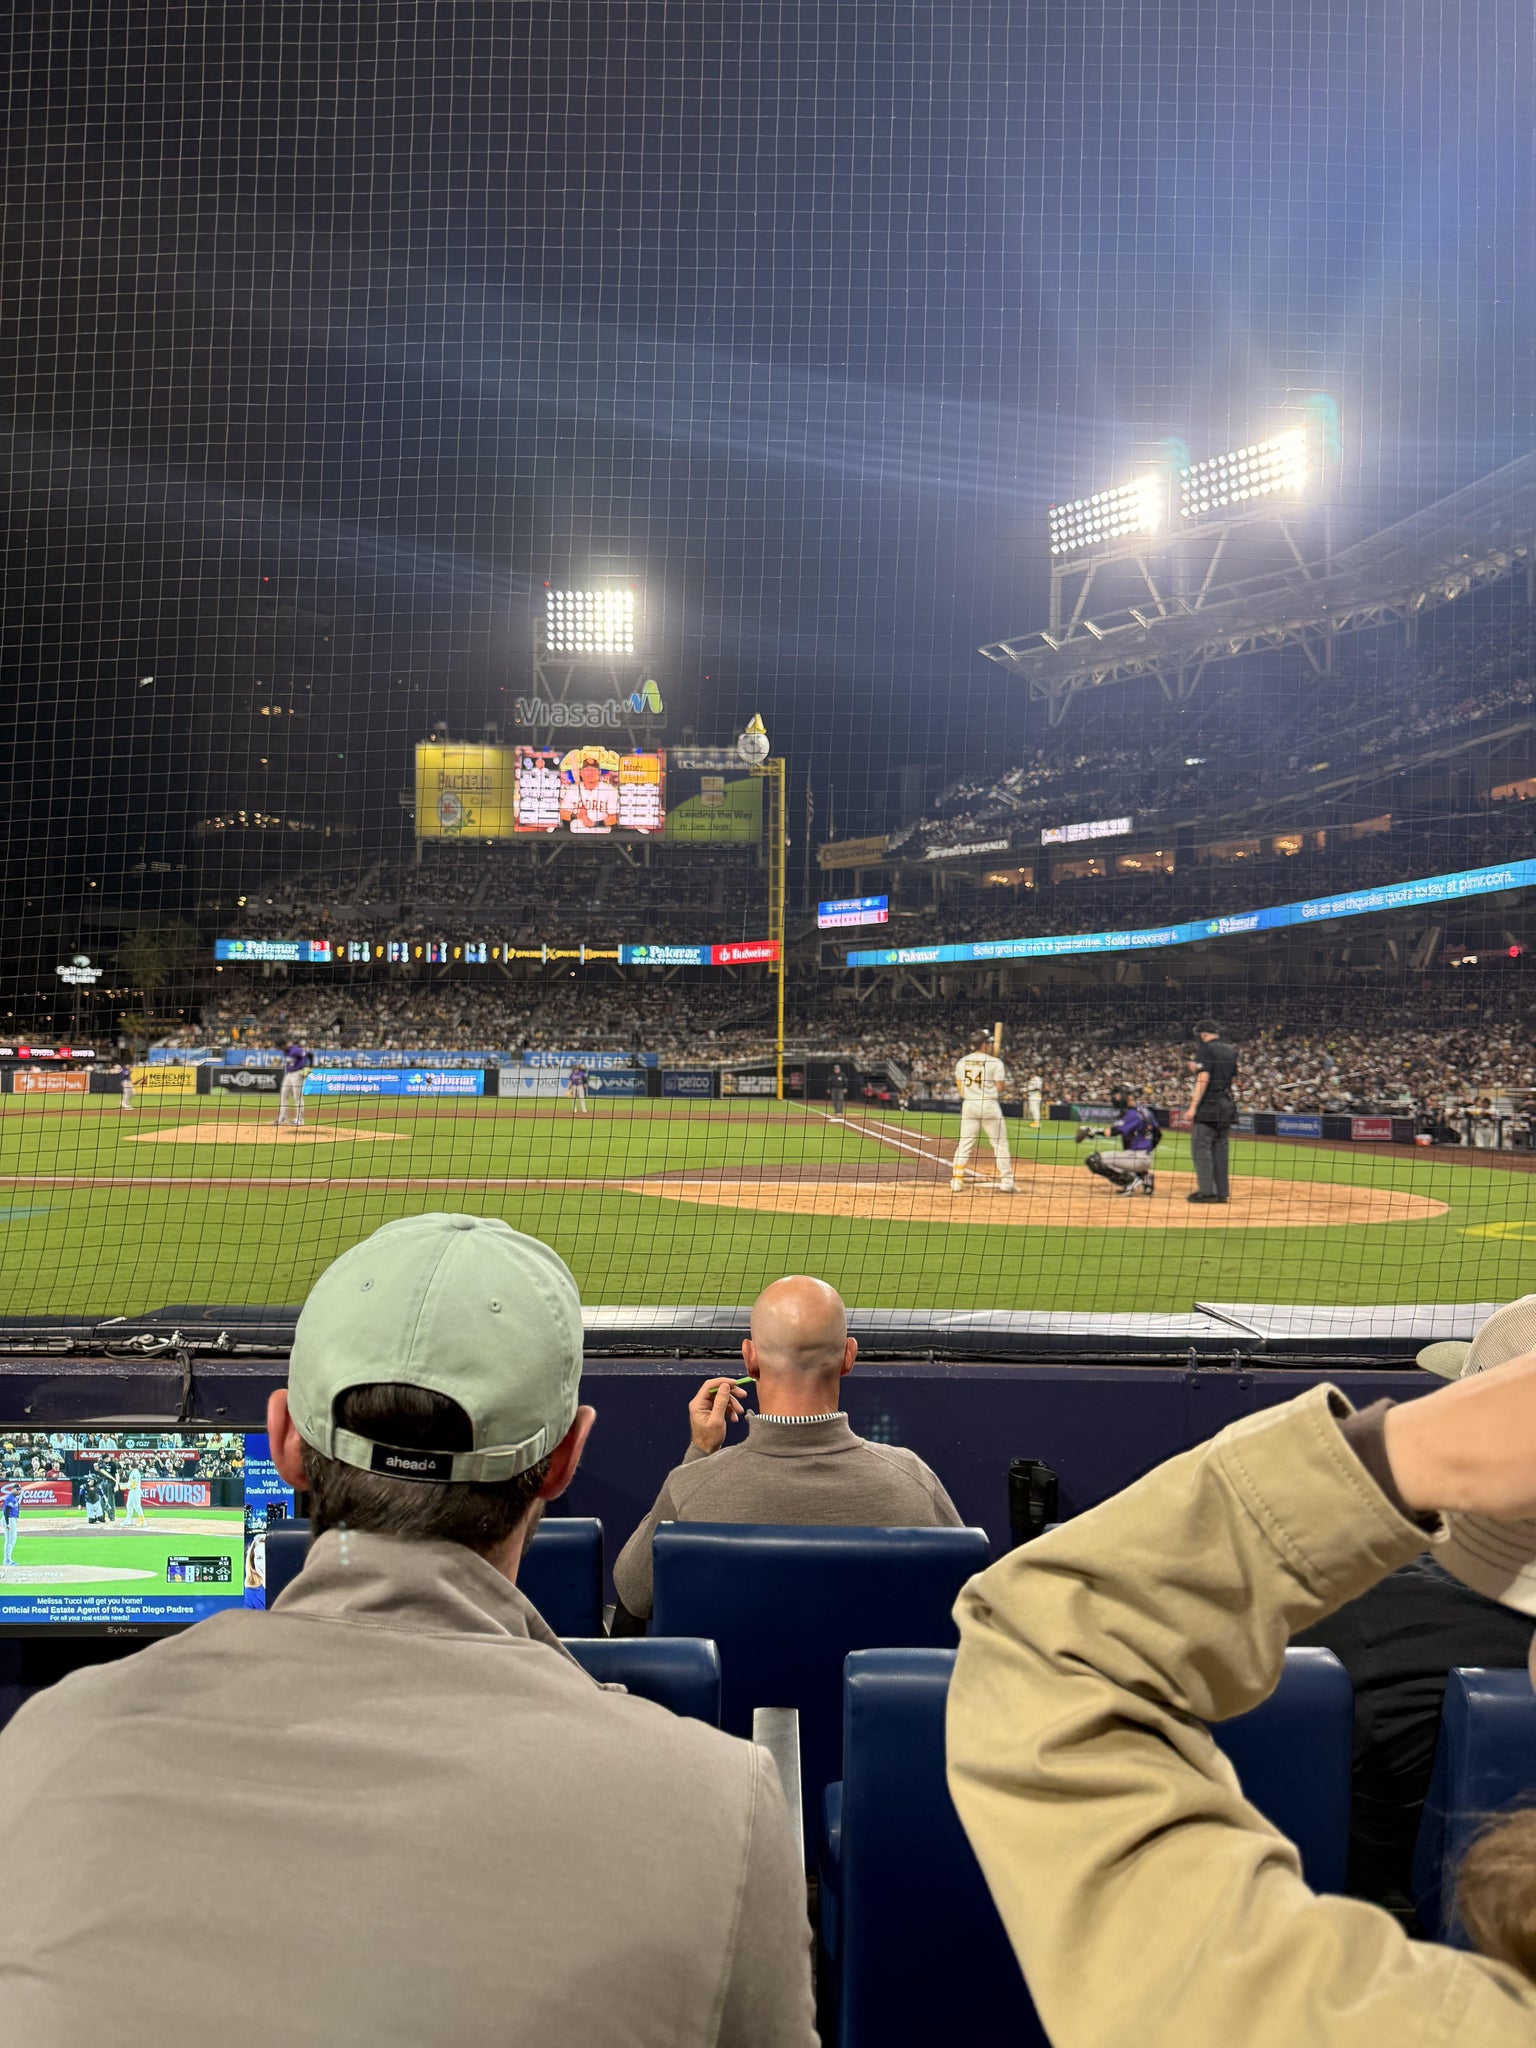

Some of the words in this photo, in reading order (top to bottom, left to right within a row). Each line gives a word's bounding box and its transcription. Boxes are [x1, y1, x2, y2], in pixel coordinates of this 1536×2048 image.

[519, 697, 621, 727] Viasat
[680, 810, 715, 821] Leading
[717, 811, 732, 819] the
[734, 810, 753, 821] Way
[1446, 879, 1457, 893] at
[245, 941, 299, 954] Palomar
[650, 945, 701, 959] Palomar
[973, 945, 994, 956] Solid
[995, 942, 1026, 957] ground
[1105, 934, 1131, 946] Solid
[732, 947, 773, 960] Budweiser
[898, 949, 940, 962] Palomar
[678, 1075, 710, 1091] petco
[964, 1070, 982, 1088] 54
[386, 1456, 427, 1471] ahead
[156, 1484, 206, 1503] YOURS!
[83, 1597, 94, 1605] will
[122, 1597, 143, 1605] home!
[77, 1606, 100, 1615] Agent
[142, 1606, 165, 1615] Diego
[107, 1626, 138, 1634] Sylvex
